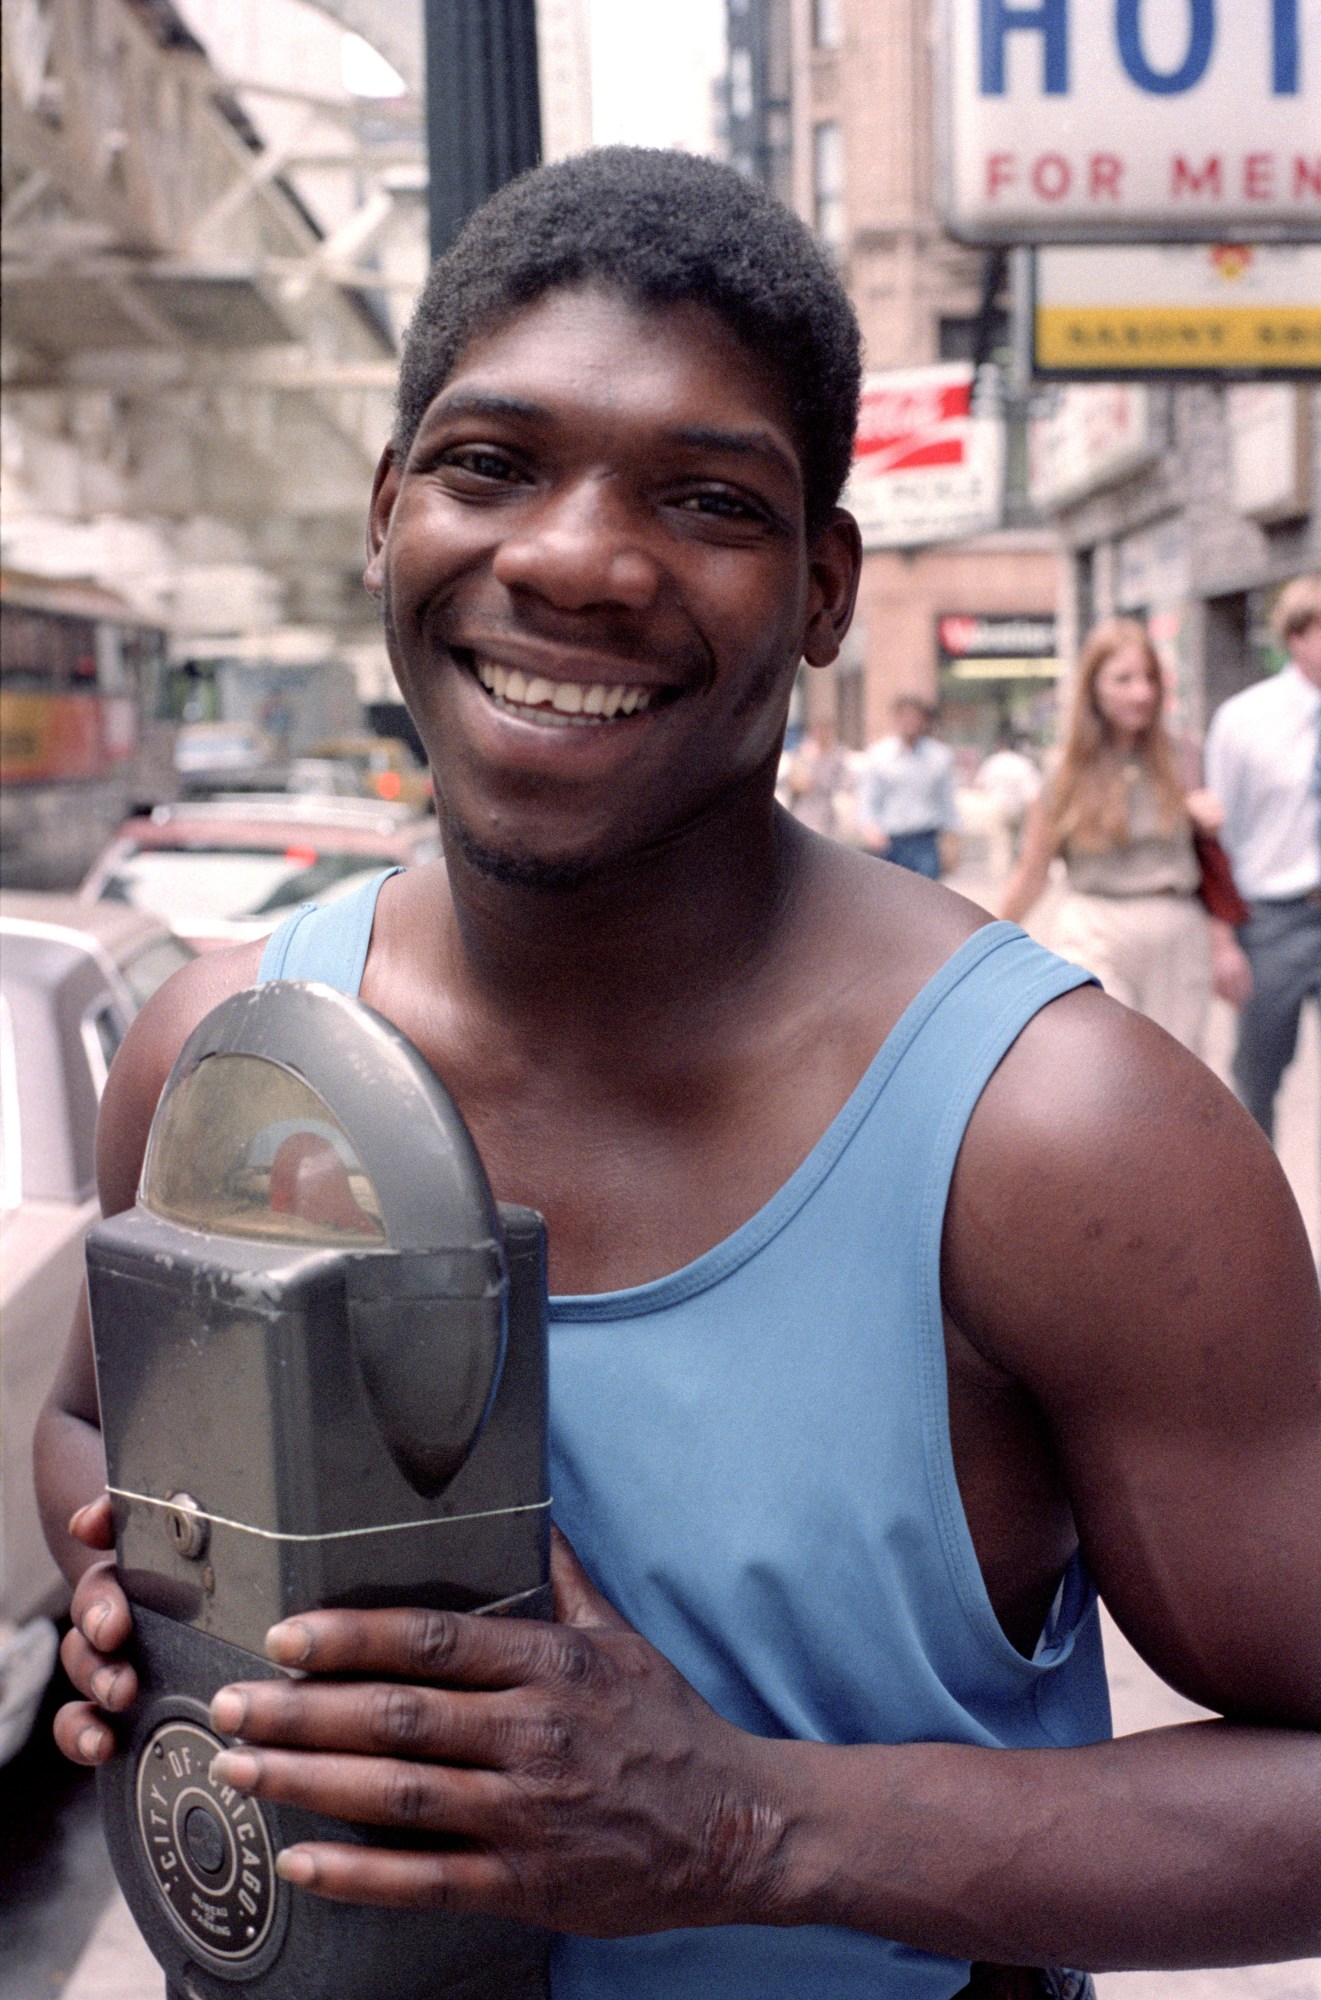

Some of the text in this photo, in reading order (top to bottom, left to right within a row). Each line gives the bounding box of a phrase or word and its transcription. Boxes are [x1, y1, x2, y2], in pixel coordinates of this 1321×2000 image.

[986, 152, 1124, 201] FOR
[150, 1782, 177, 1871] CITY
[168, 1746, 191, 1778] OF
